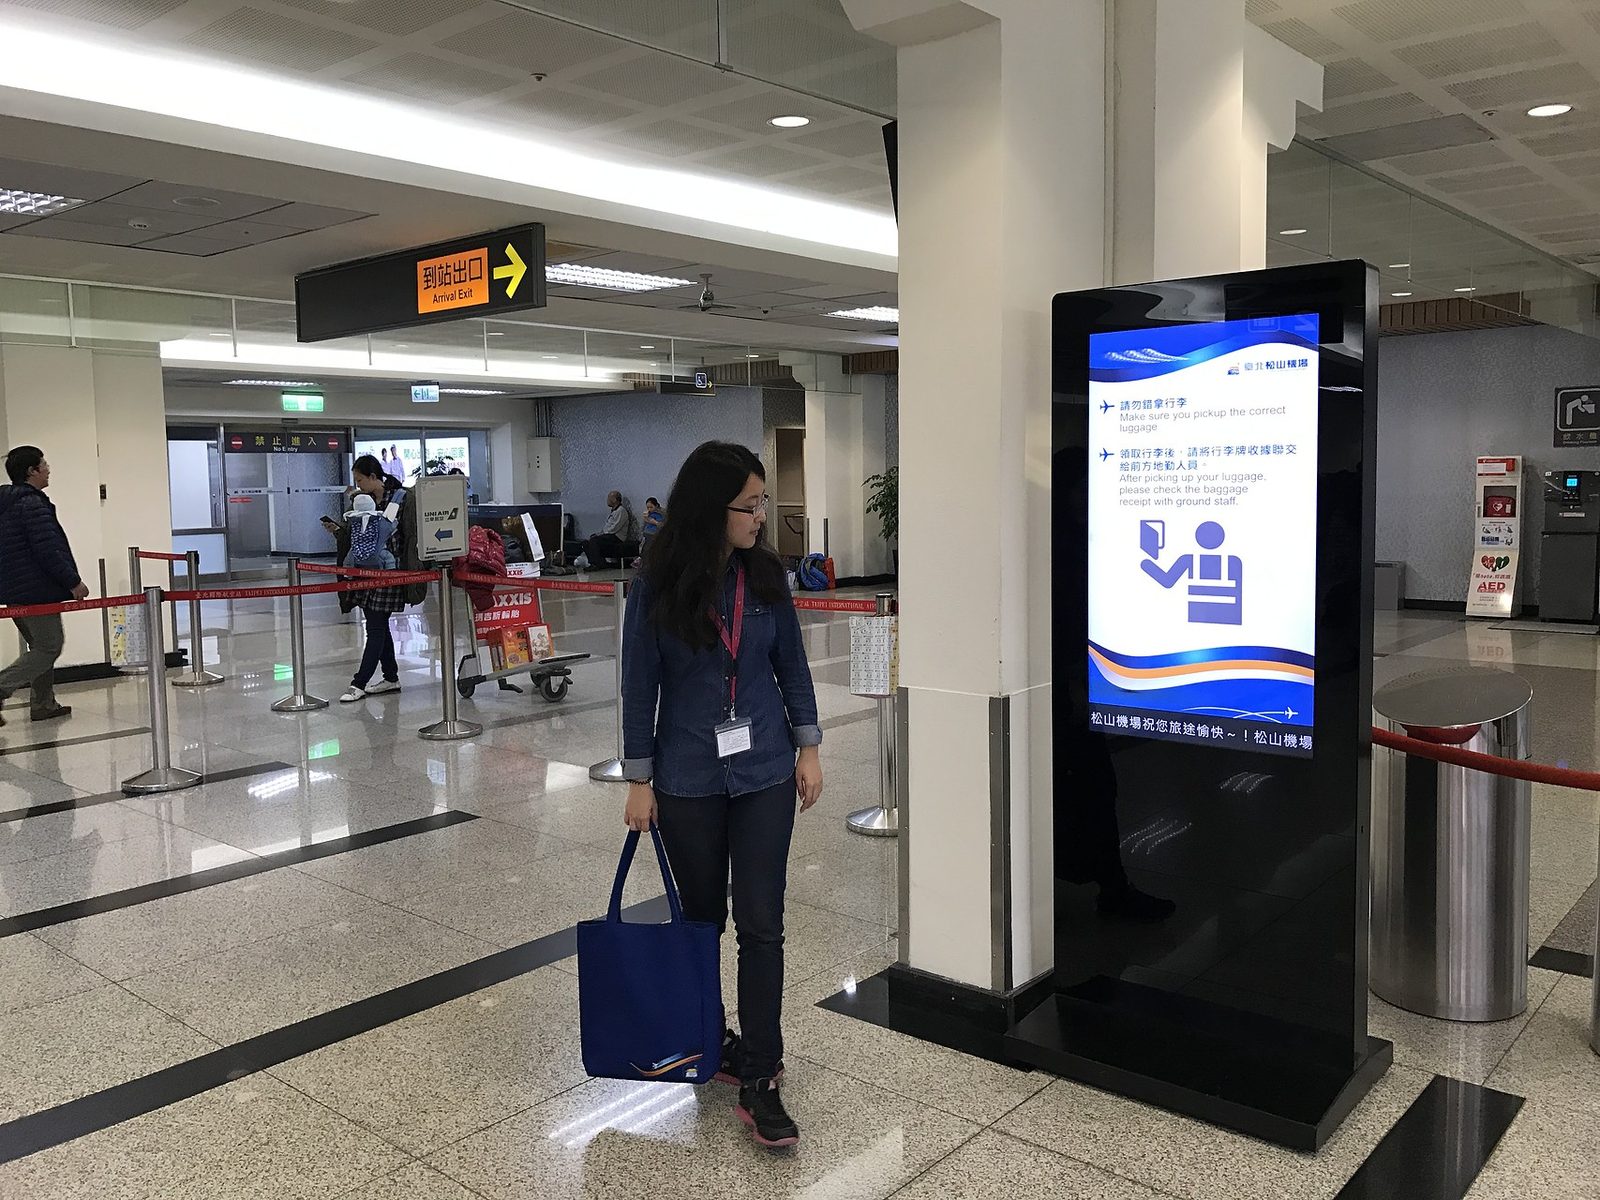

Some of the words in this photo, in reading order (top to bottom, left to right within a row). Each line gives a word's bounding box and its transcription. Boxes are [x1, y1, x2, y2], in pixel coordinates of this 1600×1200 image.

[423, 256, 483, 290] 到站出口
[432, 289, 457, 304] Arrival
[458, 287, 473, 300] Exit
[1120, 397, 1187, 411] 請勿錯拿行李
[1120, 413, 1146, 422] Make
[1148, 412, 1170, 421] sure
[1173, 412, 1191, 421] you
[1193, 409, 1227, 420] pickup
[1230, 407, 1246, 417] the
[1249, 406, 1286, 416] correct
[1119, 423, 1158, 434] luggage
[255, 435, 317, 446] 禁止進入
[1119, 474, 1142, 483] After
[1144, 473, 1178, 484] picking
[1181, 475, 1194, 484] up
[1196, 474, 1219, 484] your
[1119, 485, 1151, 496] please
[1153, 485, 1182, 494] check
[1185, 485, 1201, 494] the
[1203, 484, 1249, 495] baggage
[1119, 497, 1152, 507] receipt
[1153, 497, 1174, 506] with
[1176, 497, 1212, 508] ground
[1477, 581, 1506, 592] AED
[493, 592, 533, 608] XXIS
